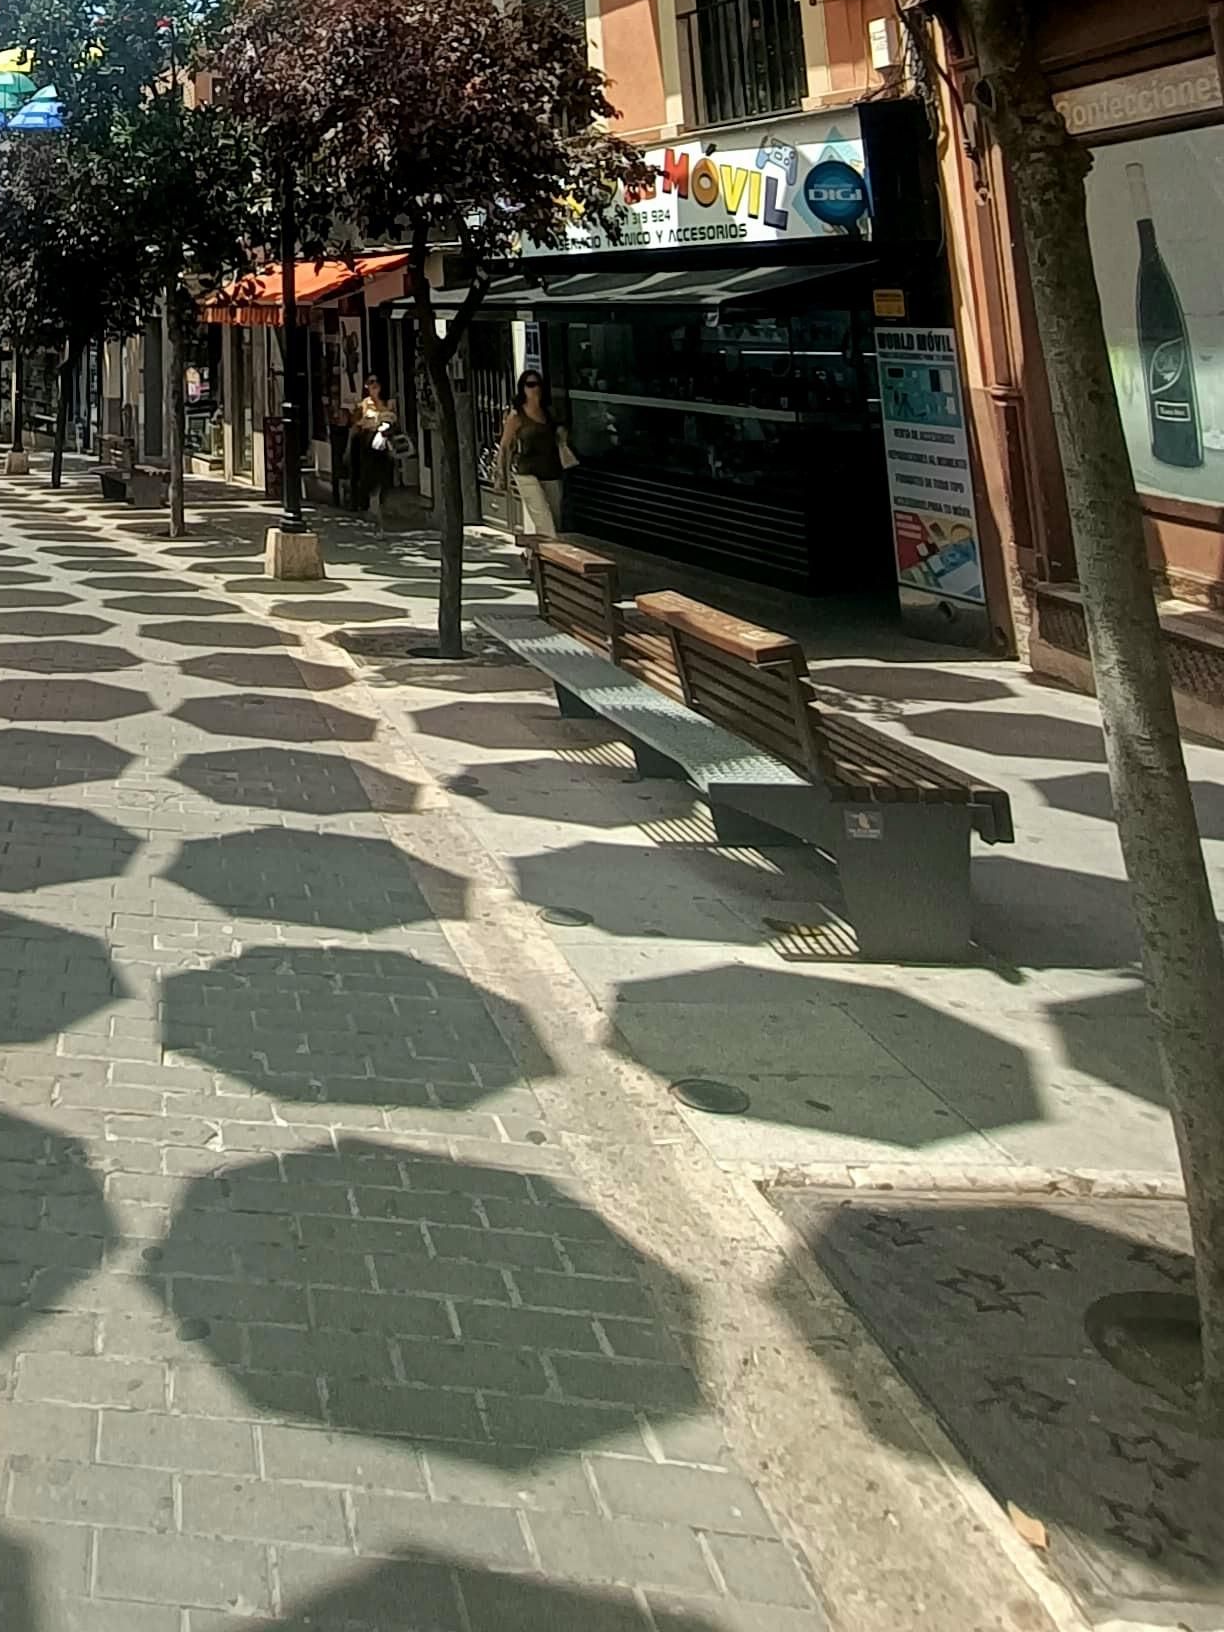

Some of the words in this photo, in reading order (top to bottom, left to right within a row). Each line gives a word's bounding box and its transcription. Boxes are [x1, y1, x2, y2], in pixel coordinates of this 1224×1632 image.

[662, 143, 789, 231] MÓVIL
[808, 188, 863, 202] DIGI
[651, 208, 671, 223] 924
[655, 229, 664, 244] Y
[668, 222, 748, 244] ACCESORIOS
[917, 330, 954, 353] MÓVIL
